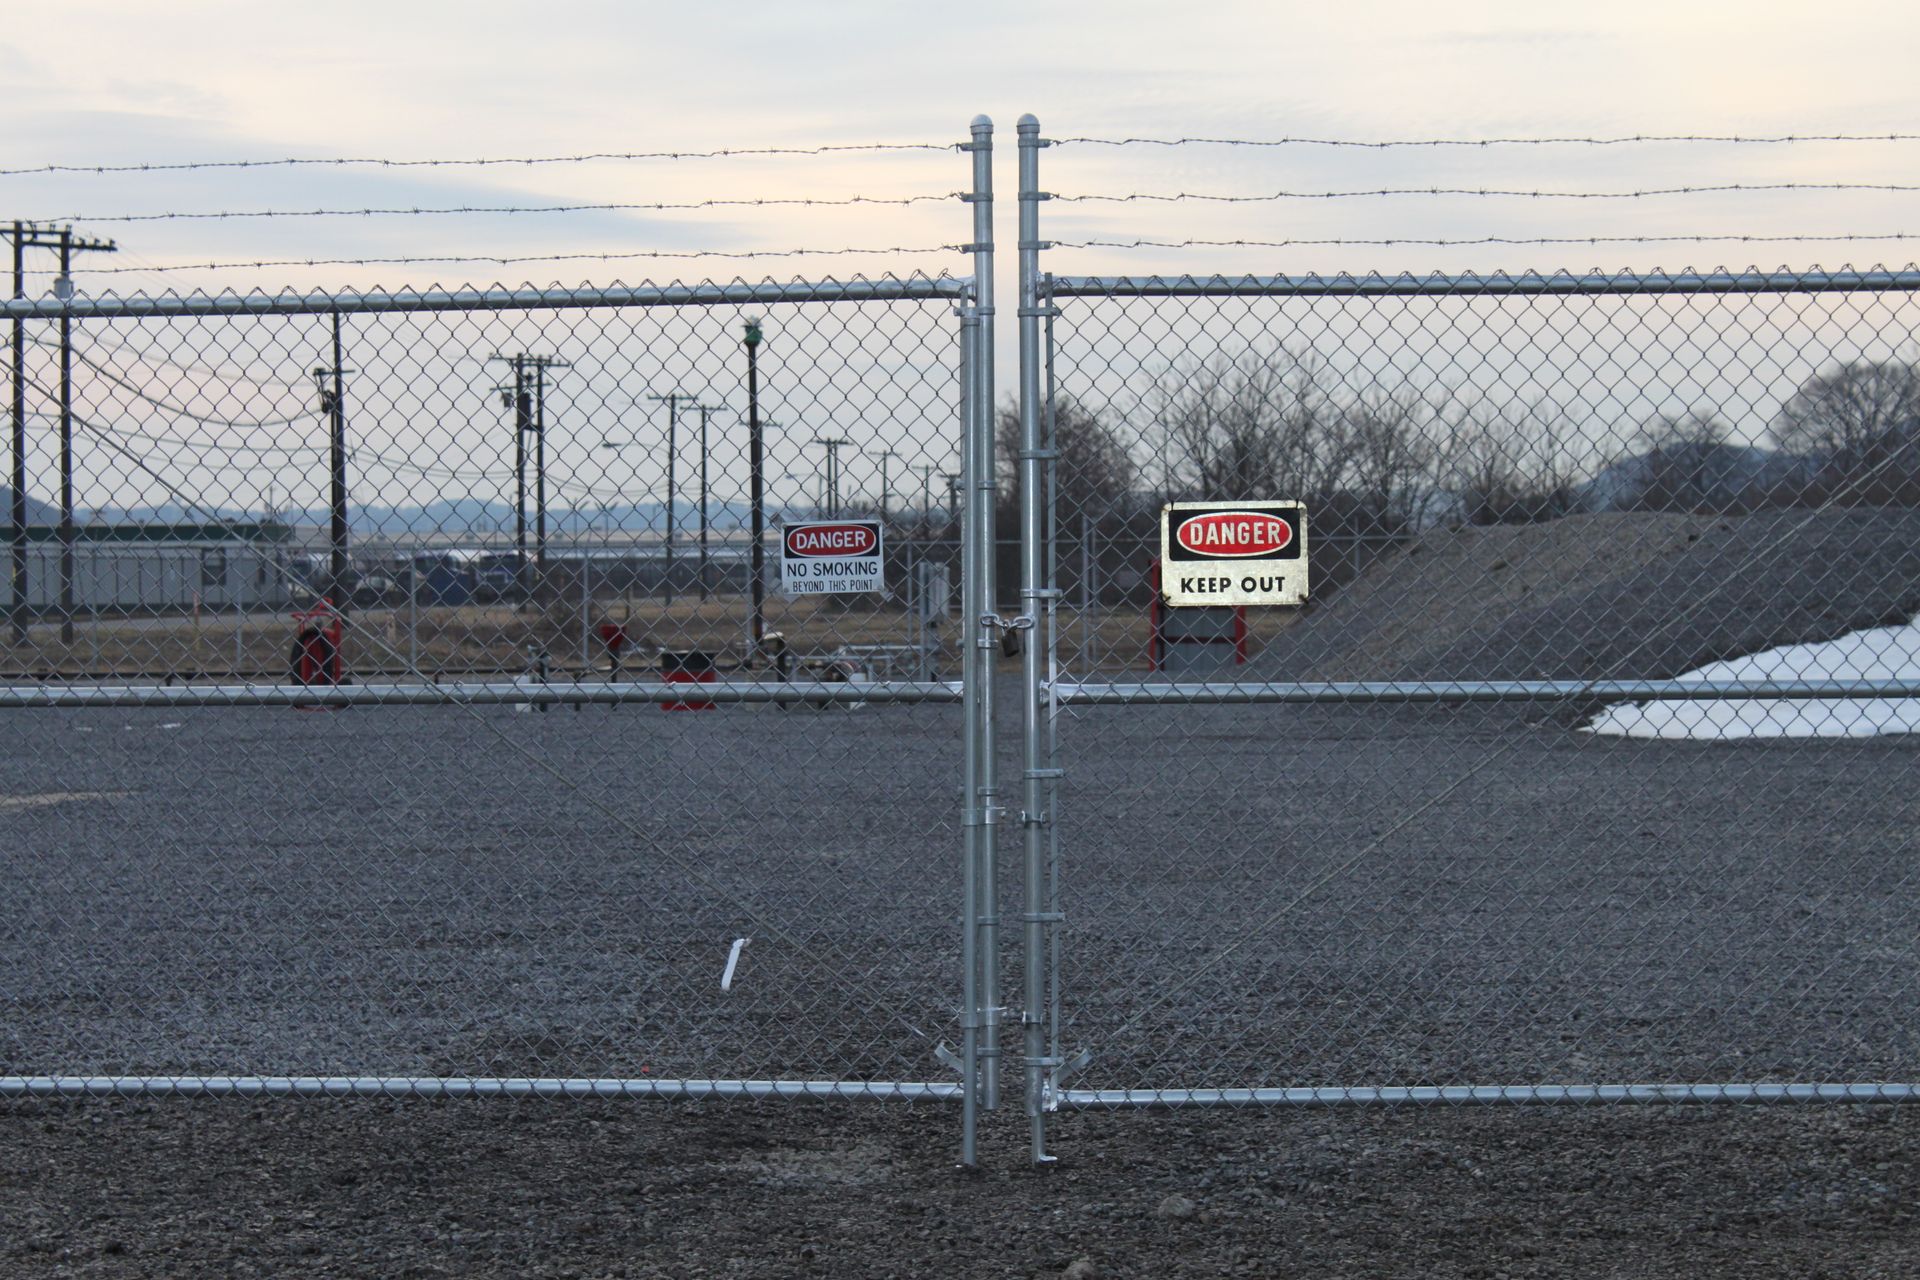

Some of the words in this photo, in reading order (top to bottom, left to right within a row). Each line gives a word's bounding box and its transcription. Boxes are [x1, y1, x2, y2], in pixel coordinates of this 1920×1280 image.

[796, 531, 866, 549] DANGER
[1190, 521, 1281, 545] DANGER
[787, 563, 807, 577] NO
[813, 561, 877, 576] SMOKING
[793, 581, 824, 592] BEYOND
[829, 580, 846, 591] THIS
[850, 579, 872, 590] POINT
[1181, 577, 1231, 593] KEEP
[1241, 576, 1285, 593] OUT
